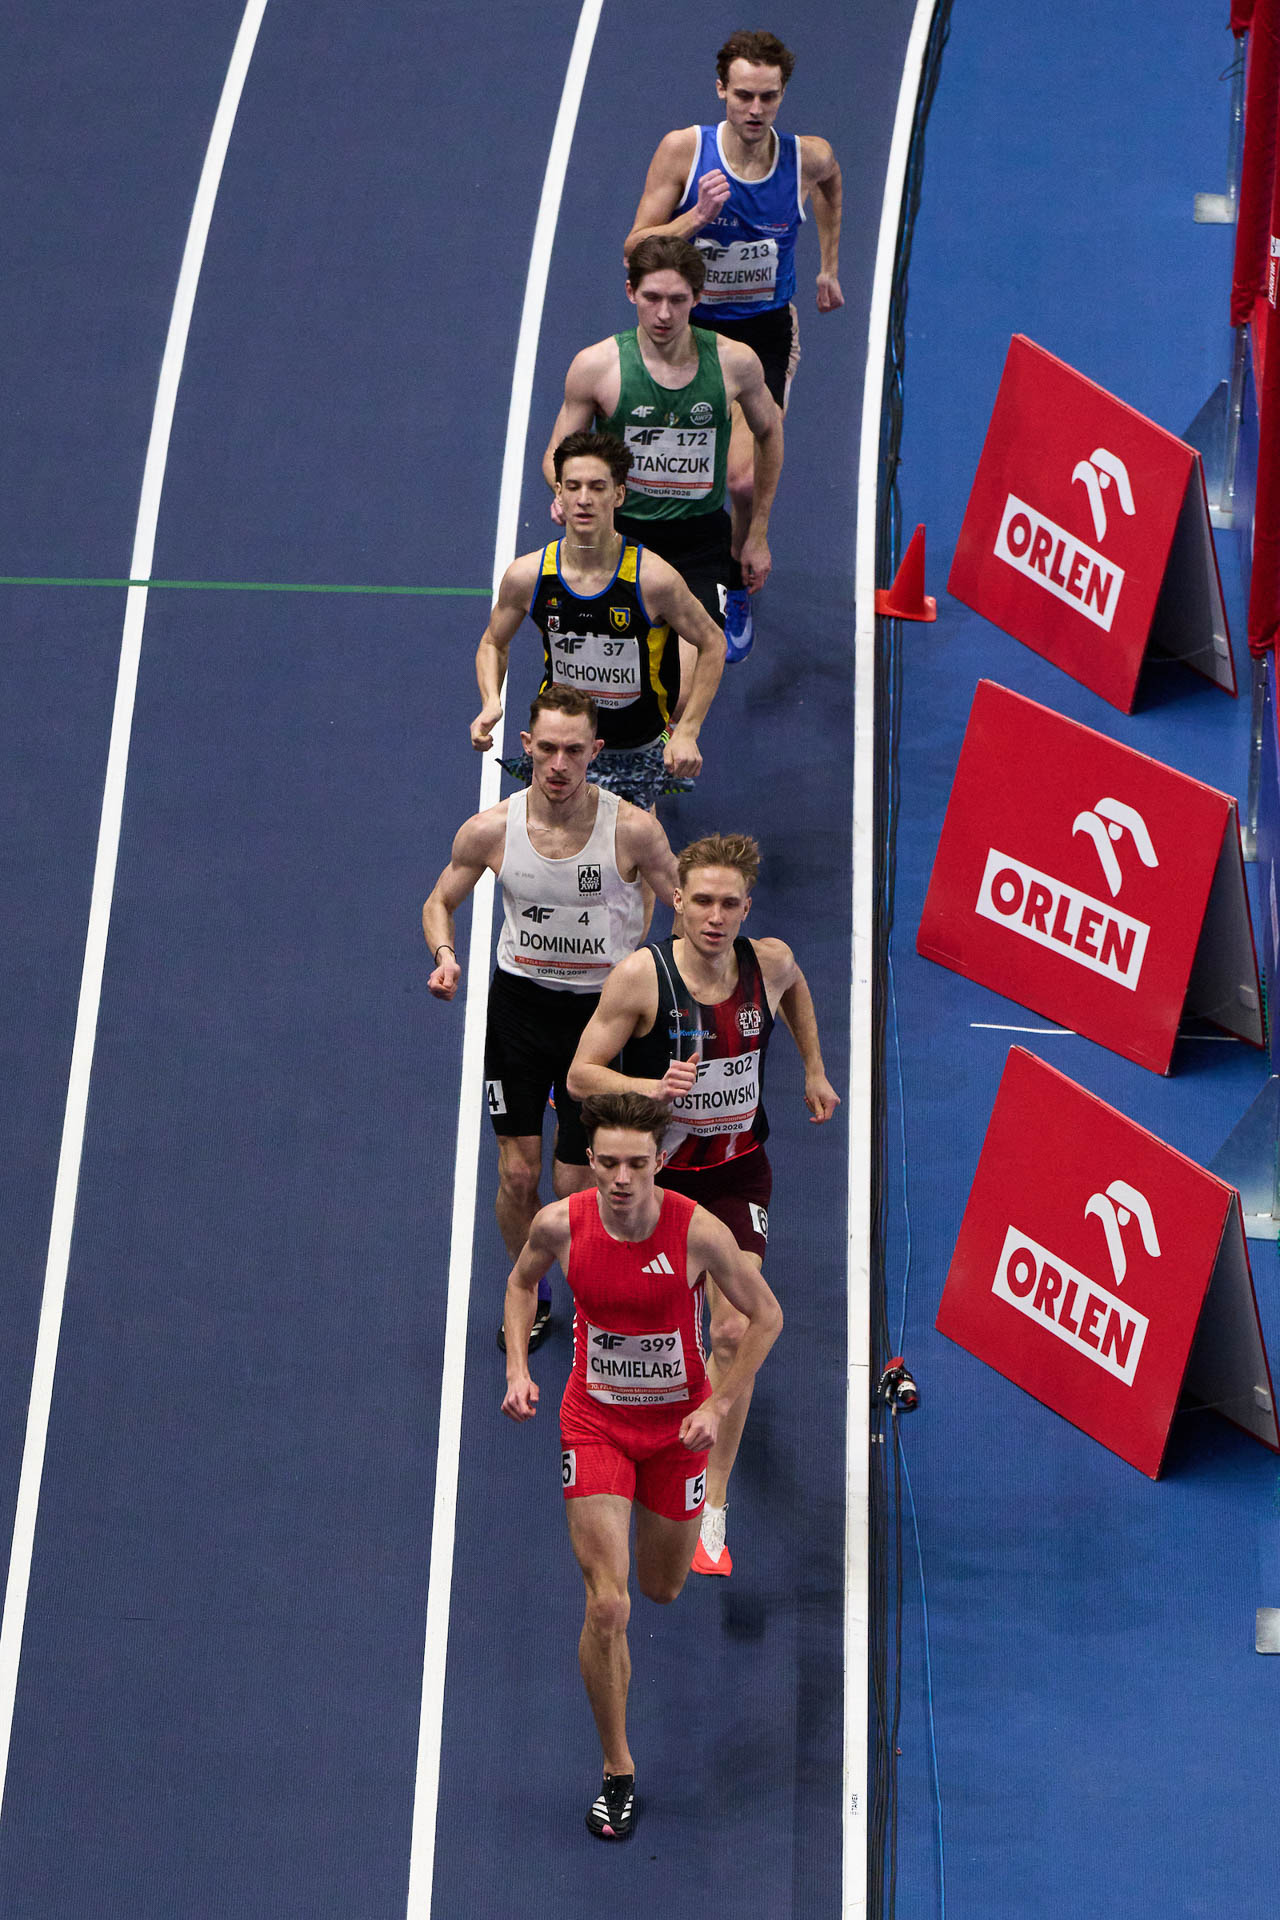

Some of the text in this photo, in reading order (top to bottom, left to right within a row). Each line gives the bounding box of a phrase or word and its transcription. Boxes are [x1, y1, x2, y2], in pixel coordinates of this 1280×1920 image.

[740, 244, 770, 261] 213
[706, 267, 772, 285] ERZEJEWSKI
[630, 429, 708, 447] 4F 172
[1006, 512, 1114, 617] ORLEN
[555, 637, 624, 656] 4F 37
[555, 660, 635, 684] CICHOWSKI
[522, 905, 590, 926] 4F 4
[990, 867, 1137, 975] ORLEN
[520, 930, 606, 955] DOMINIAK
[724, 1056, 753, 1077] 302
[488, 1083, 499, 1111] 4
[672, 1082, 756, 1109] OSTROWSKI
[758, 1207, 769, 1235] 6
[1006, 1246, 1137, 1369] ORLEN
[592, 1333, 676, 1352] 4F 399
[591, 1357, 683, 1379] CHMIELARZ
[562, 1453, 572, 1484] 5
[692, 1474, 705, 1505] 5
